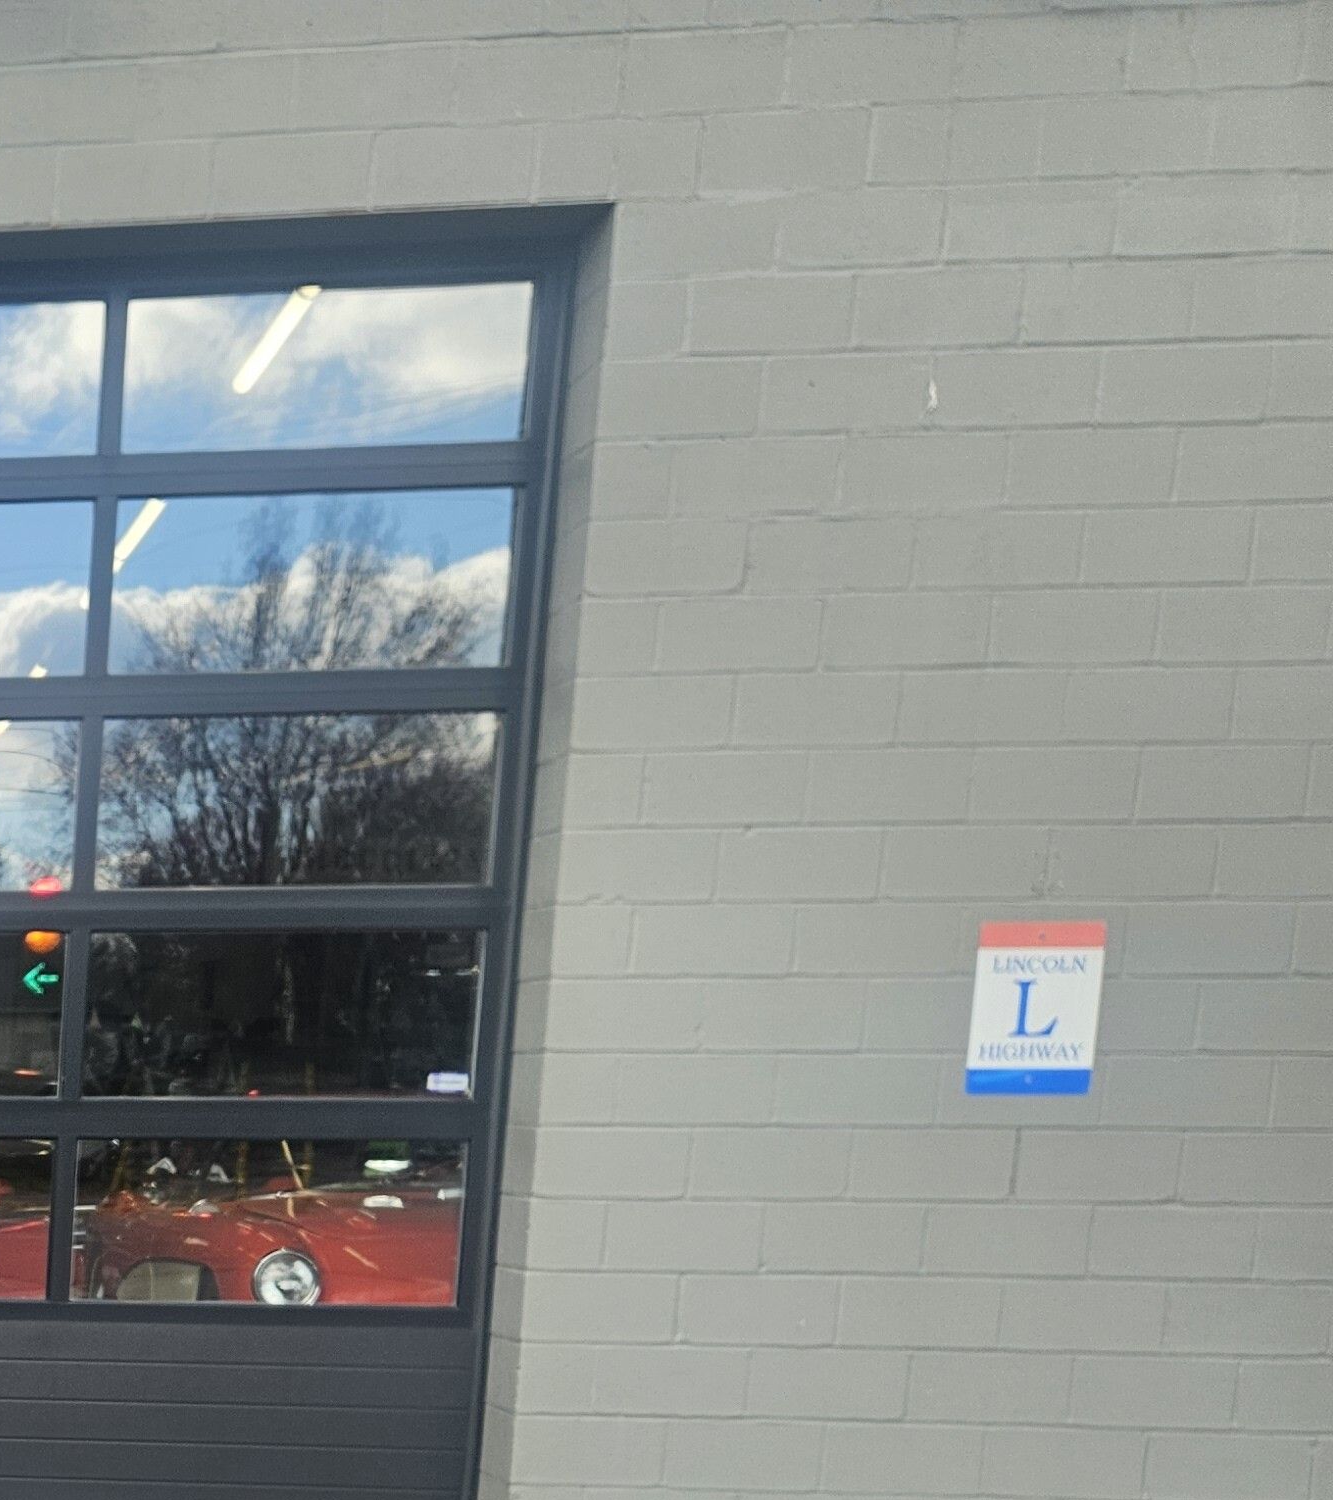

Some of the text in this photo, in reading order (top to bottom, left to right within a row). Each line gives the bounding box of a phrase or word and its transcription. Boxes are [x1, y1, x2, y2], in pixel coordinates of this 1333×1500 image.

[993, 955, 1088, 974] LINCOLN
[1008, 978, 1059, 1038] L
[978, 1041, 1085, 1062] HIGHWAY
